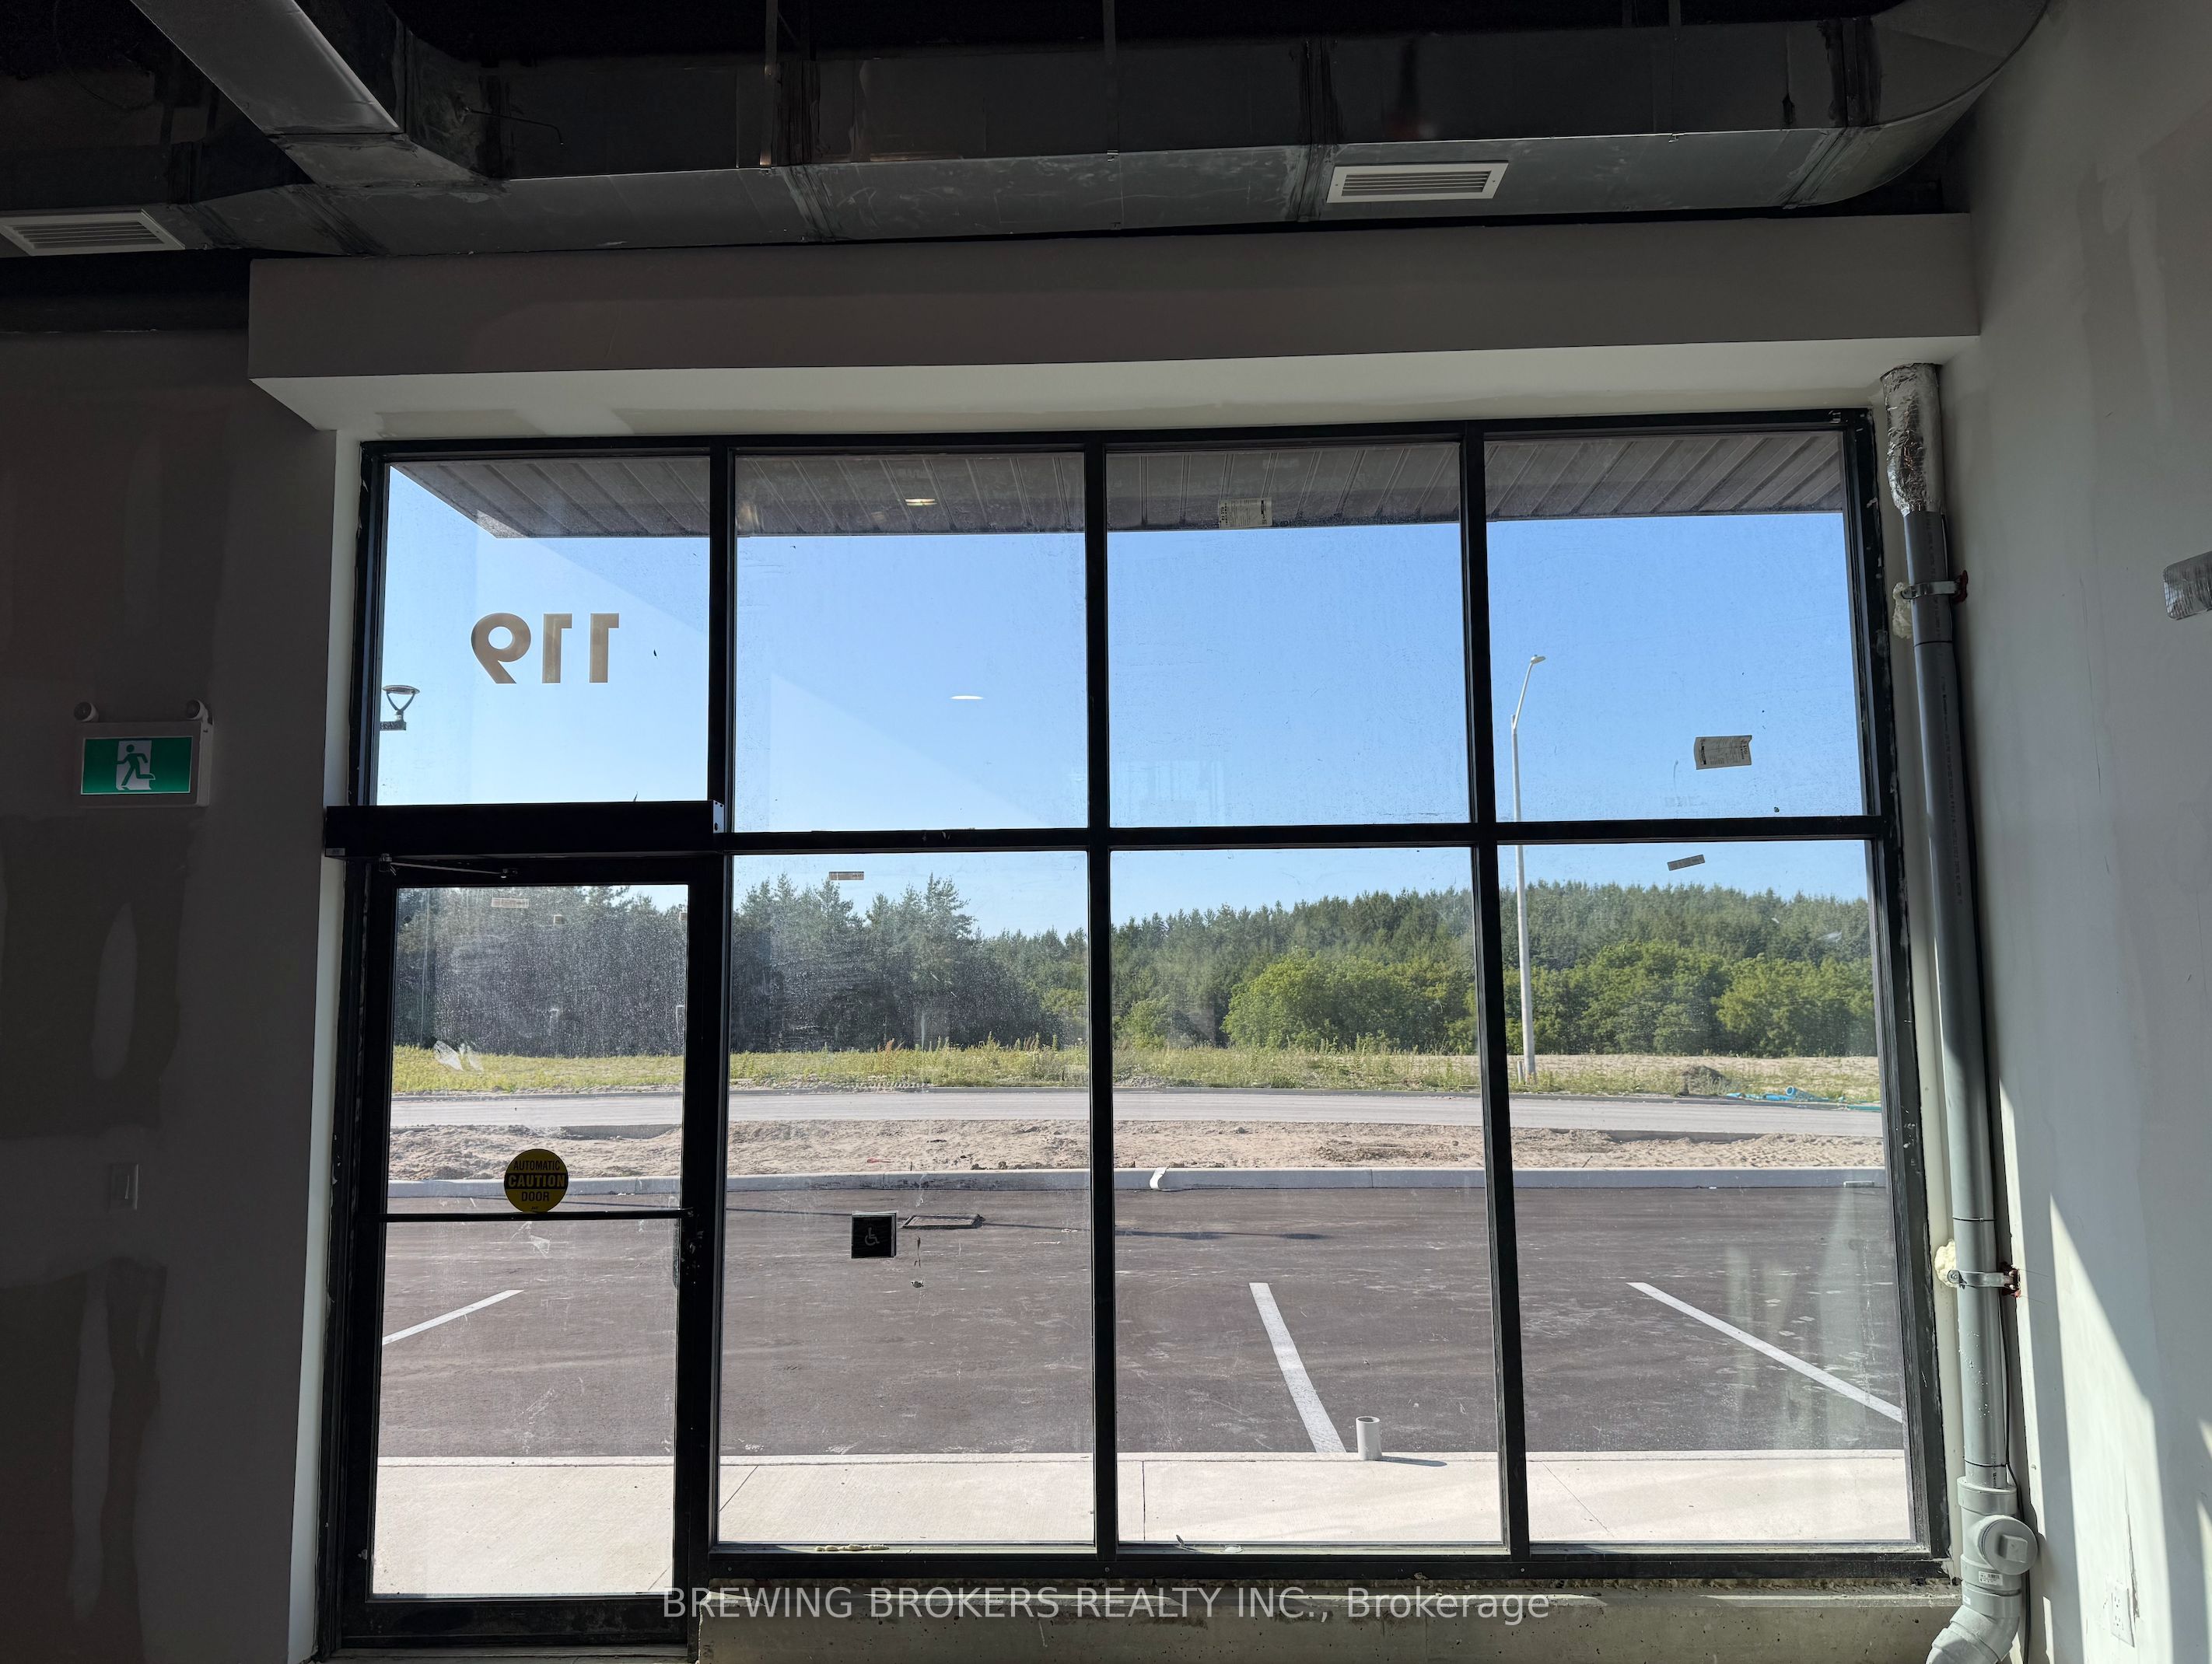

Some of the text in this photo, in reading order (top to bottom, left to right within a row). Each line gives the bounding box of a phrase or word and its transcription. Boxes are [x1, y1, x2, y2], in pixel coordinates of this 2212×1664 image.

[513, 1159, 560, 1170] AUTOMATIC
[508, 1174, 565, 1187] CAUTION
[521, 1191, 550, 1201] DOOR
